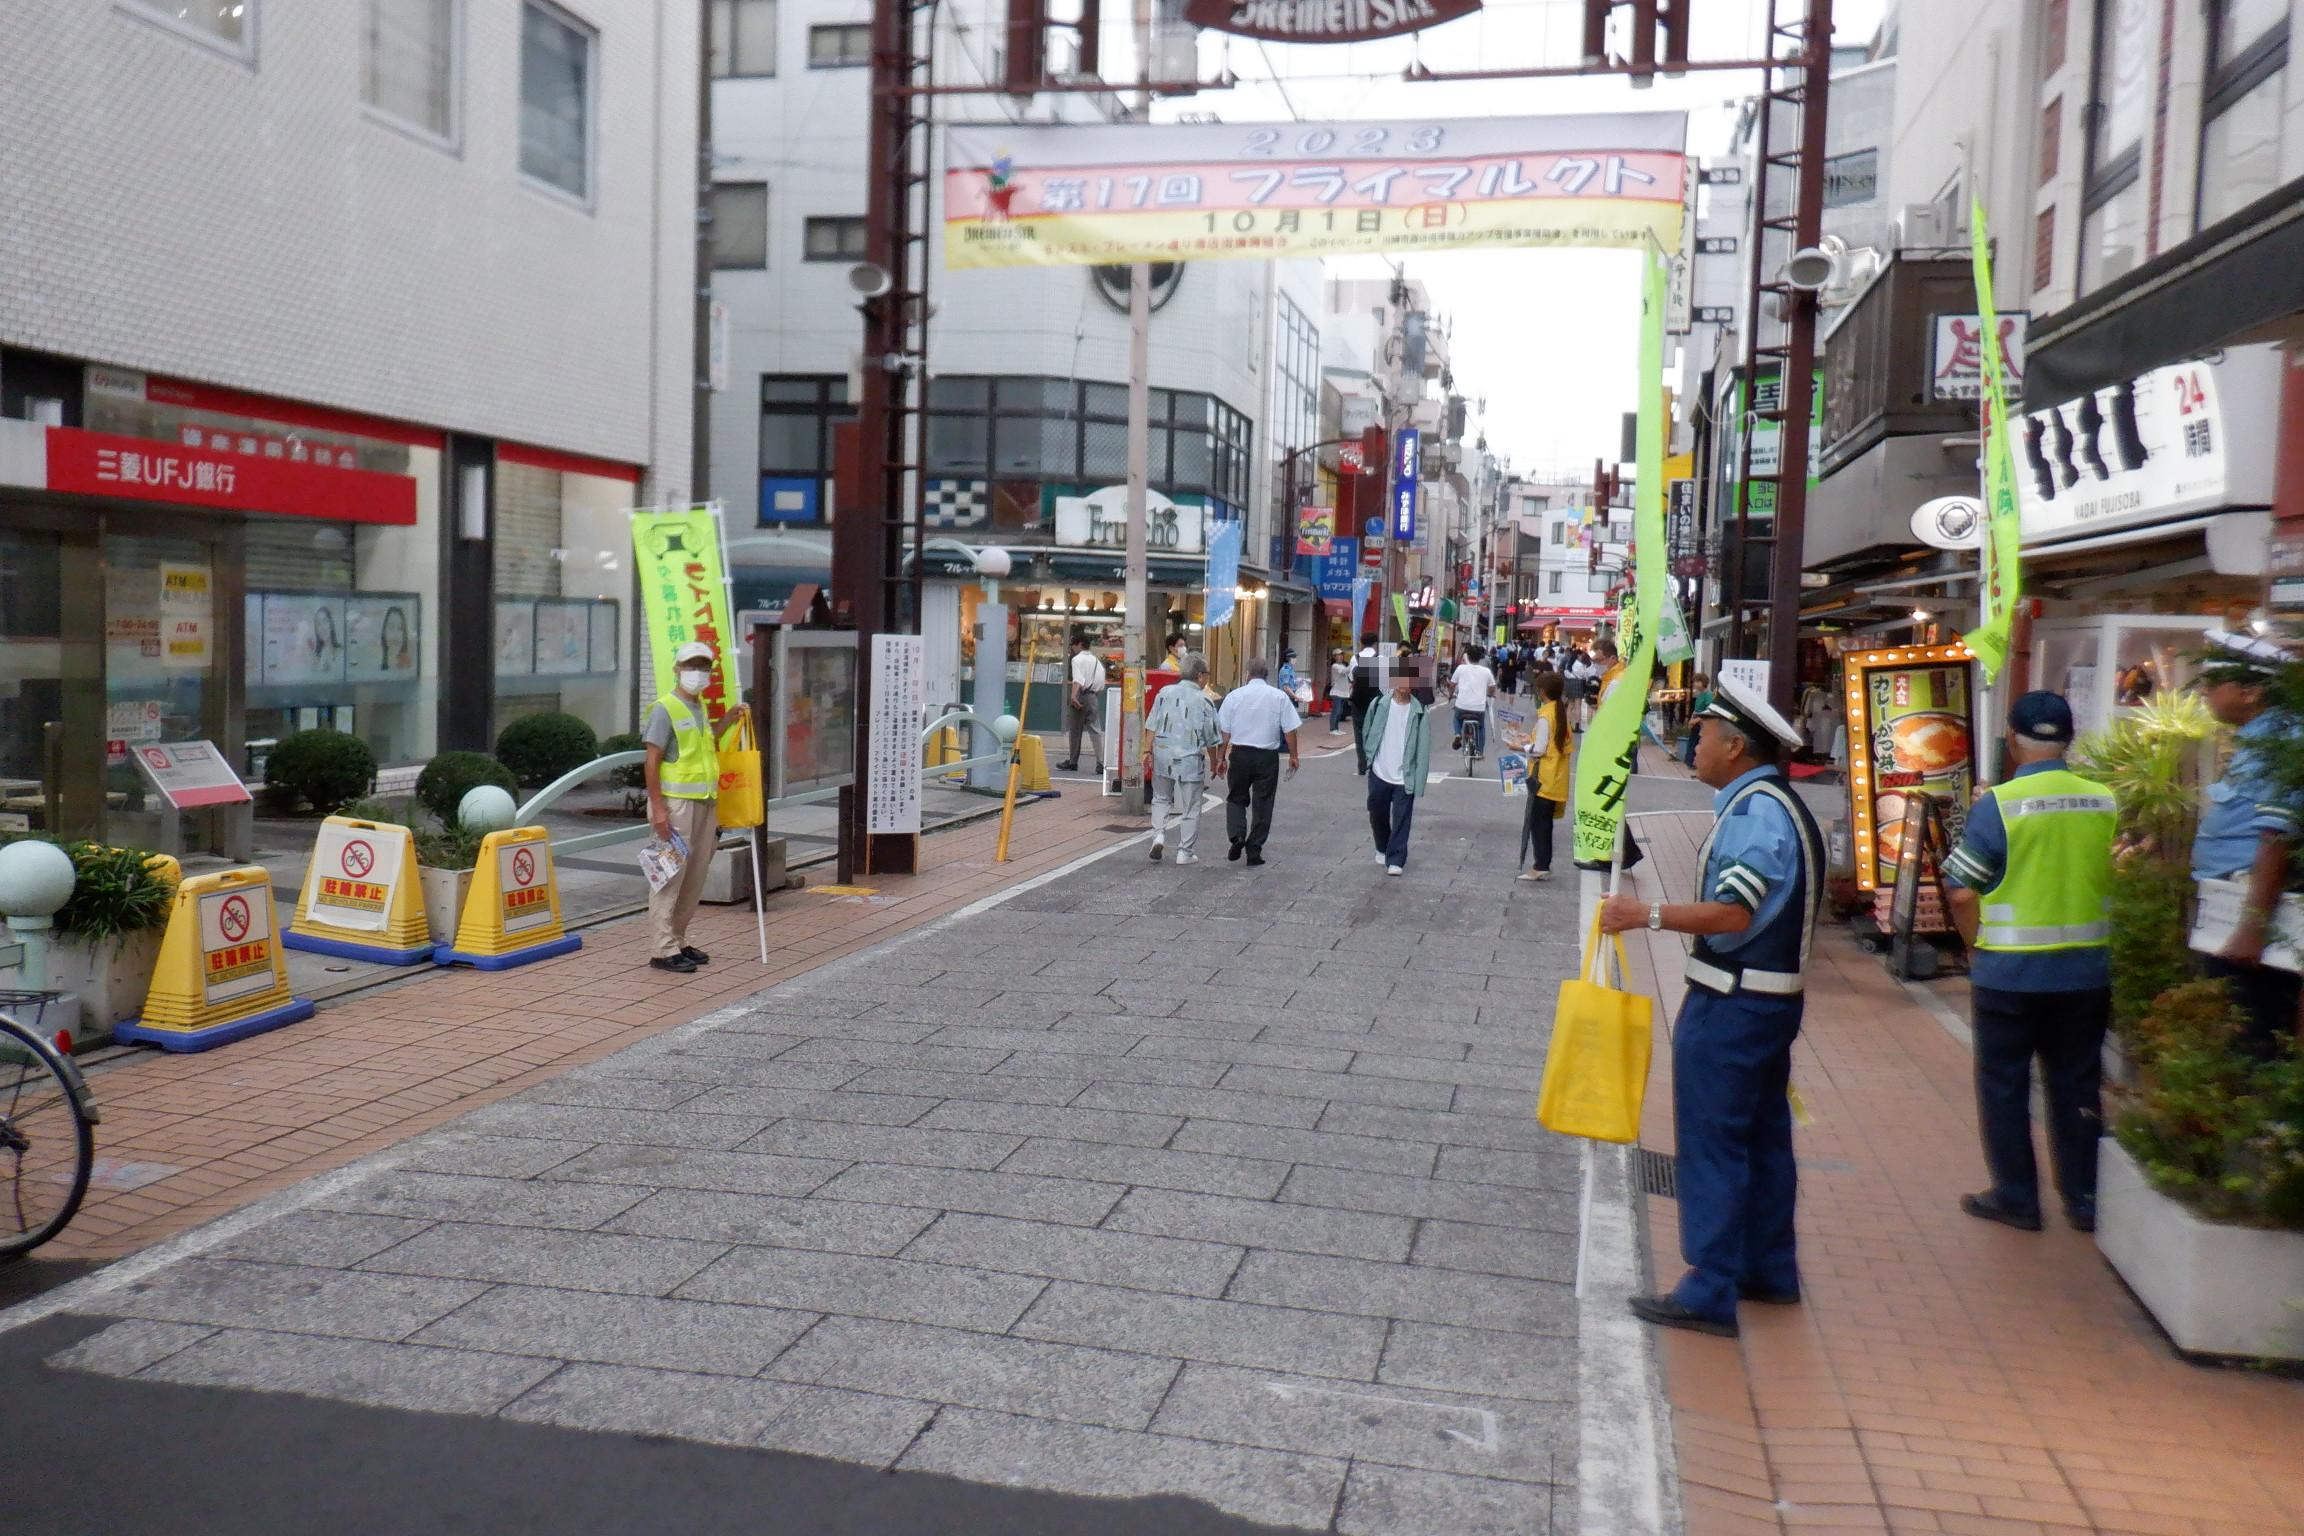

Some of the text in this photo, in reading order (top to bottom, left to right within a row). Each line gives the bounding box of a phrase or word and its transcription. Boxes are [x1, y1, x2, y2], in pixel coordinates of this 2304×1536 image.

[1240, 126, 1446, 156] 2023
[1040, 155, 1656, 212] 第17回 フライマルクト
[2174, 370, 2205, 415] 24
[96, 447, 236, 493] 三菱UFJ銀行
[175, 622, 199, 633] ATM
[324, 879, 383, 900] 駐輪禁止
[507, 887, 545, 907] 駐輪禁止
[211, 943, 265, 971] 駐輪禁止
